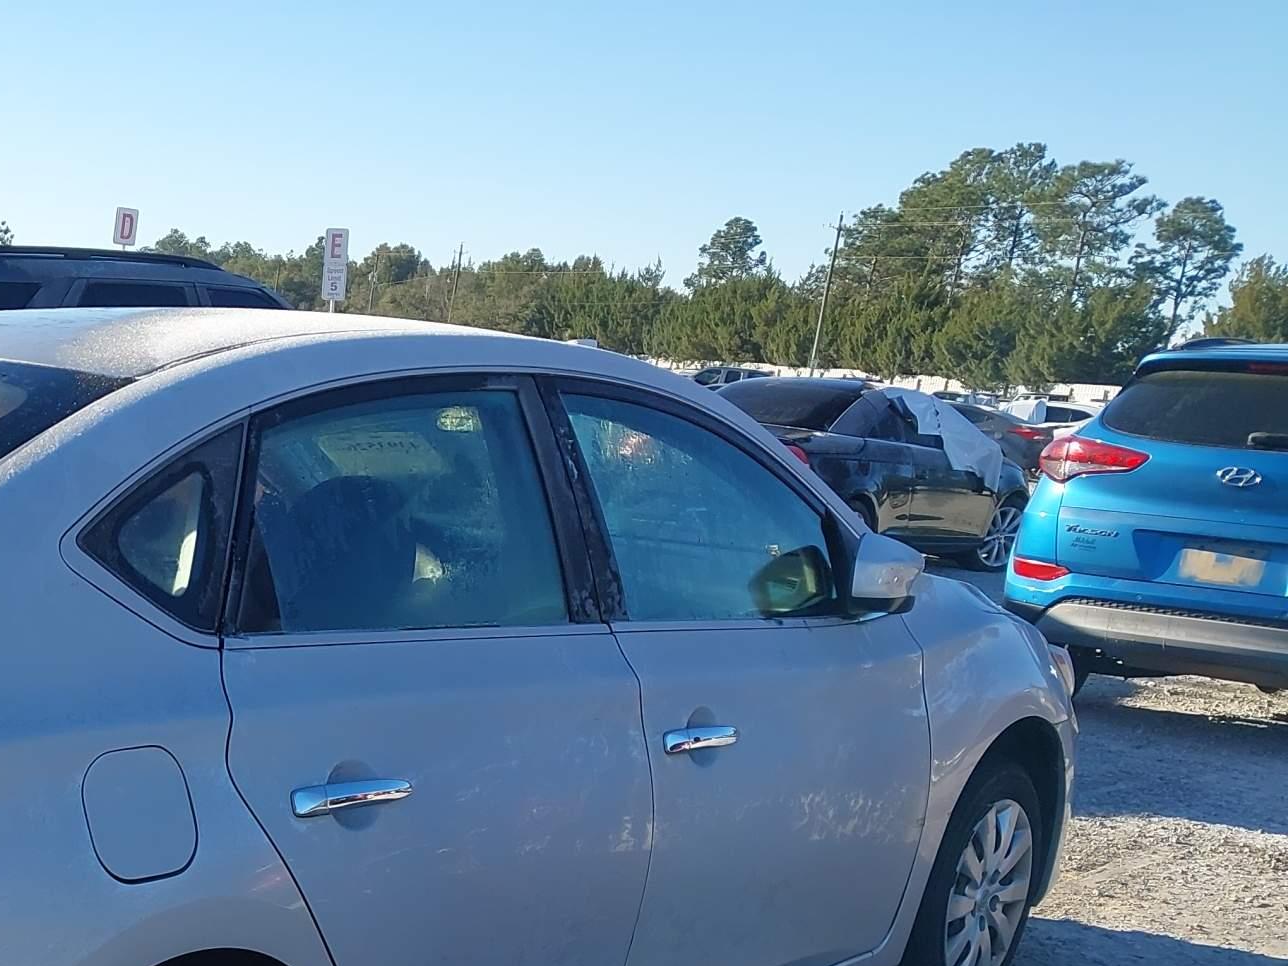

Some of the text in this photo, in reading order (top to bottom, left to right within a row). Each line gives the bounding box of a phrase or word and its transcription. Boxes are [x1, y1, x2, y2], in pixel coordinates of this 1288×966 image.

[119, 213, 134, 240] D
[330, 233, 343, 259] E
[330, 282, 338, 291] 5
